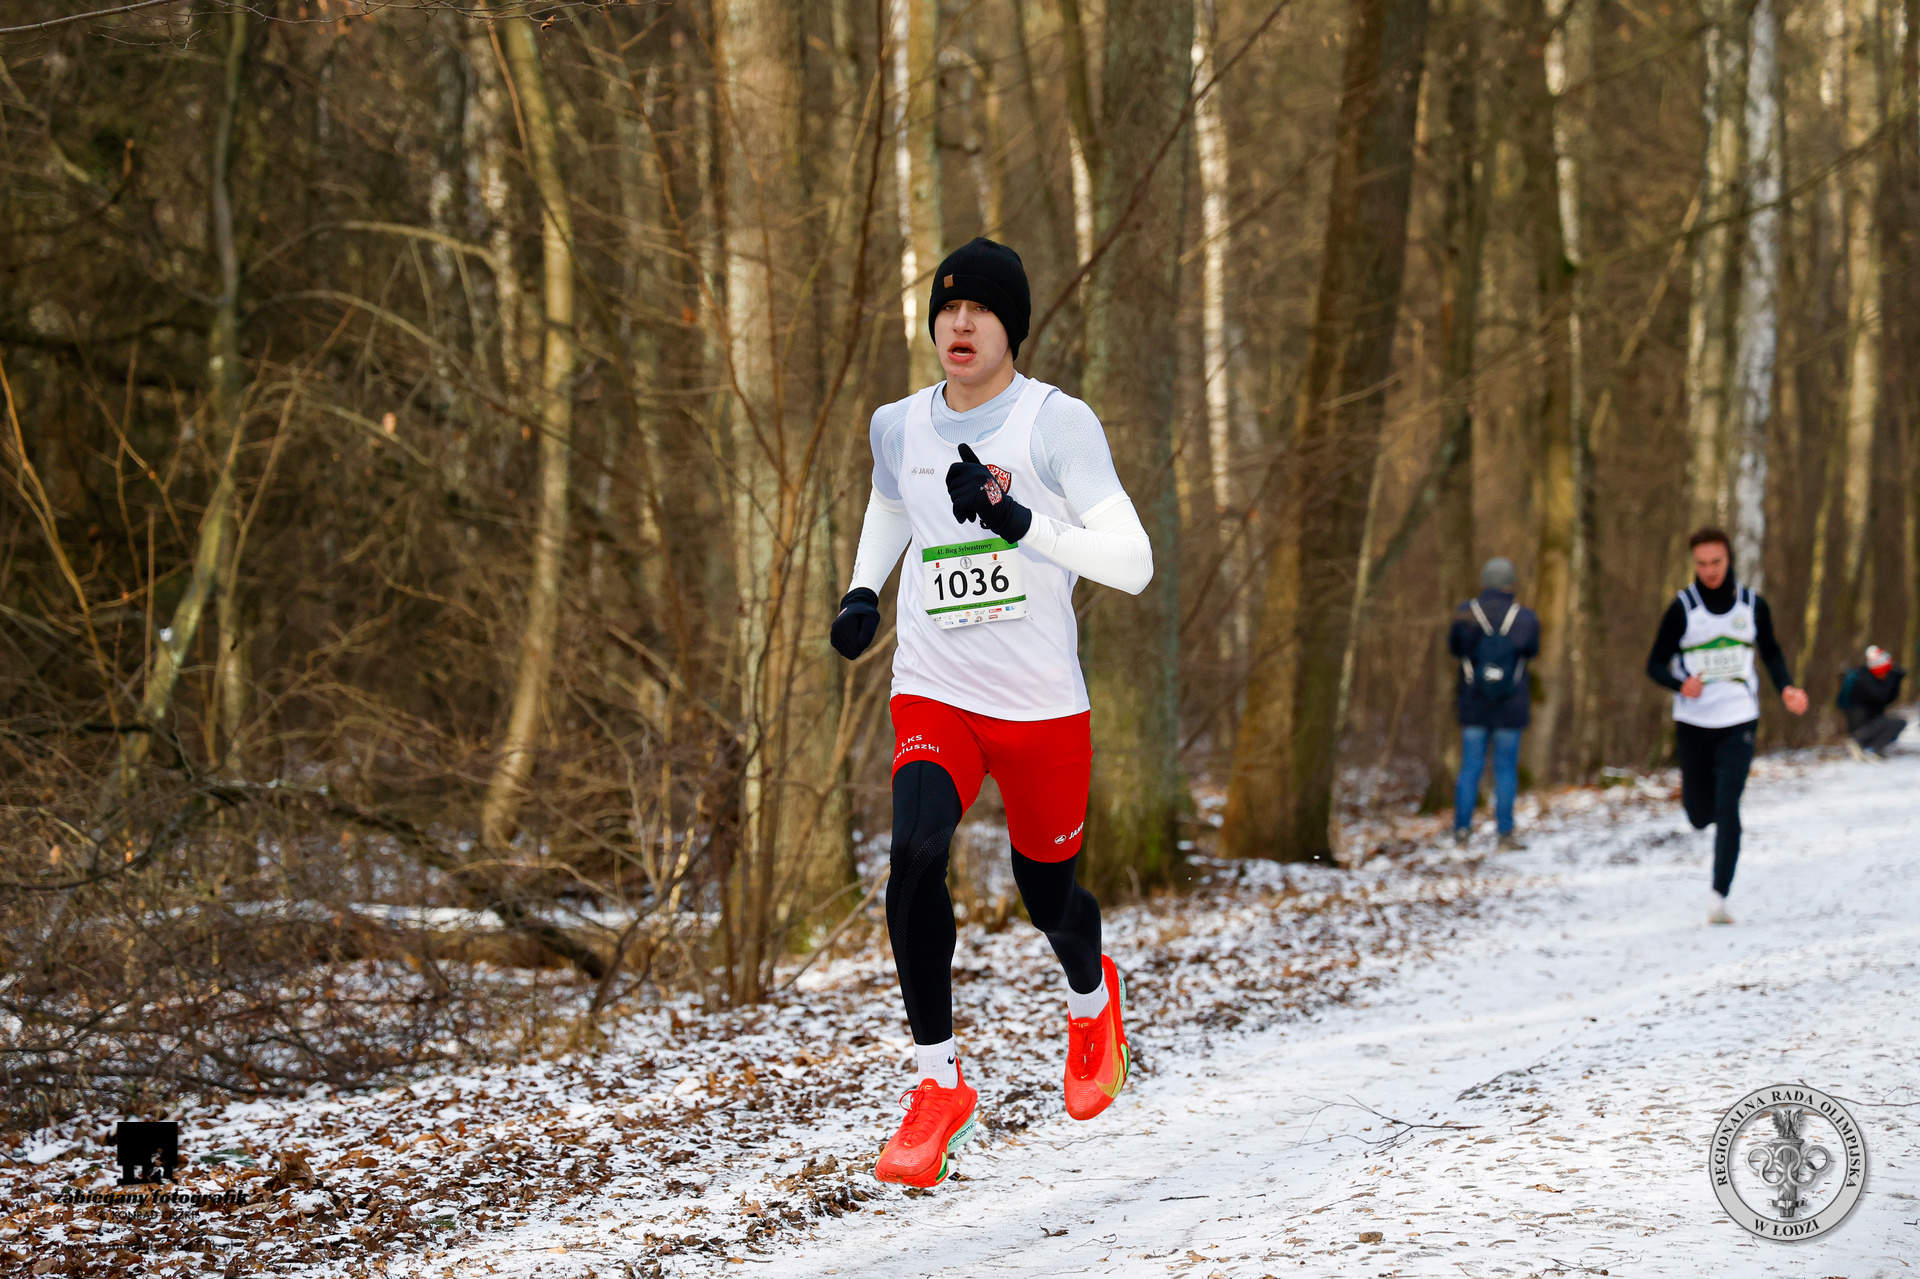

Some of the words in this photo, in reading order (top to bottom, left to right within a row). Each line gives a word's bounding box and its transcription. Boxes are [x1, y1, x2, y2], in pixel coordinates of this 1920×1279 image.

[919, 467, 935, 475] JAKO
[934, 565, 1010, 601] 1036
[901, 734, 923, 747] LKS
